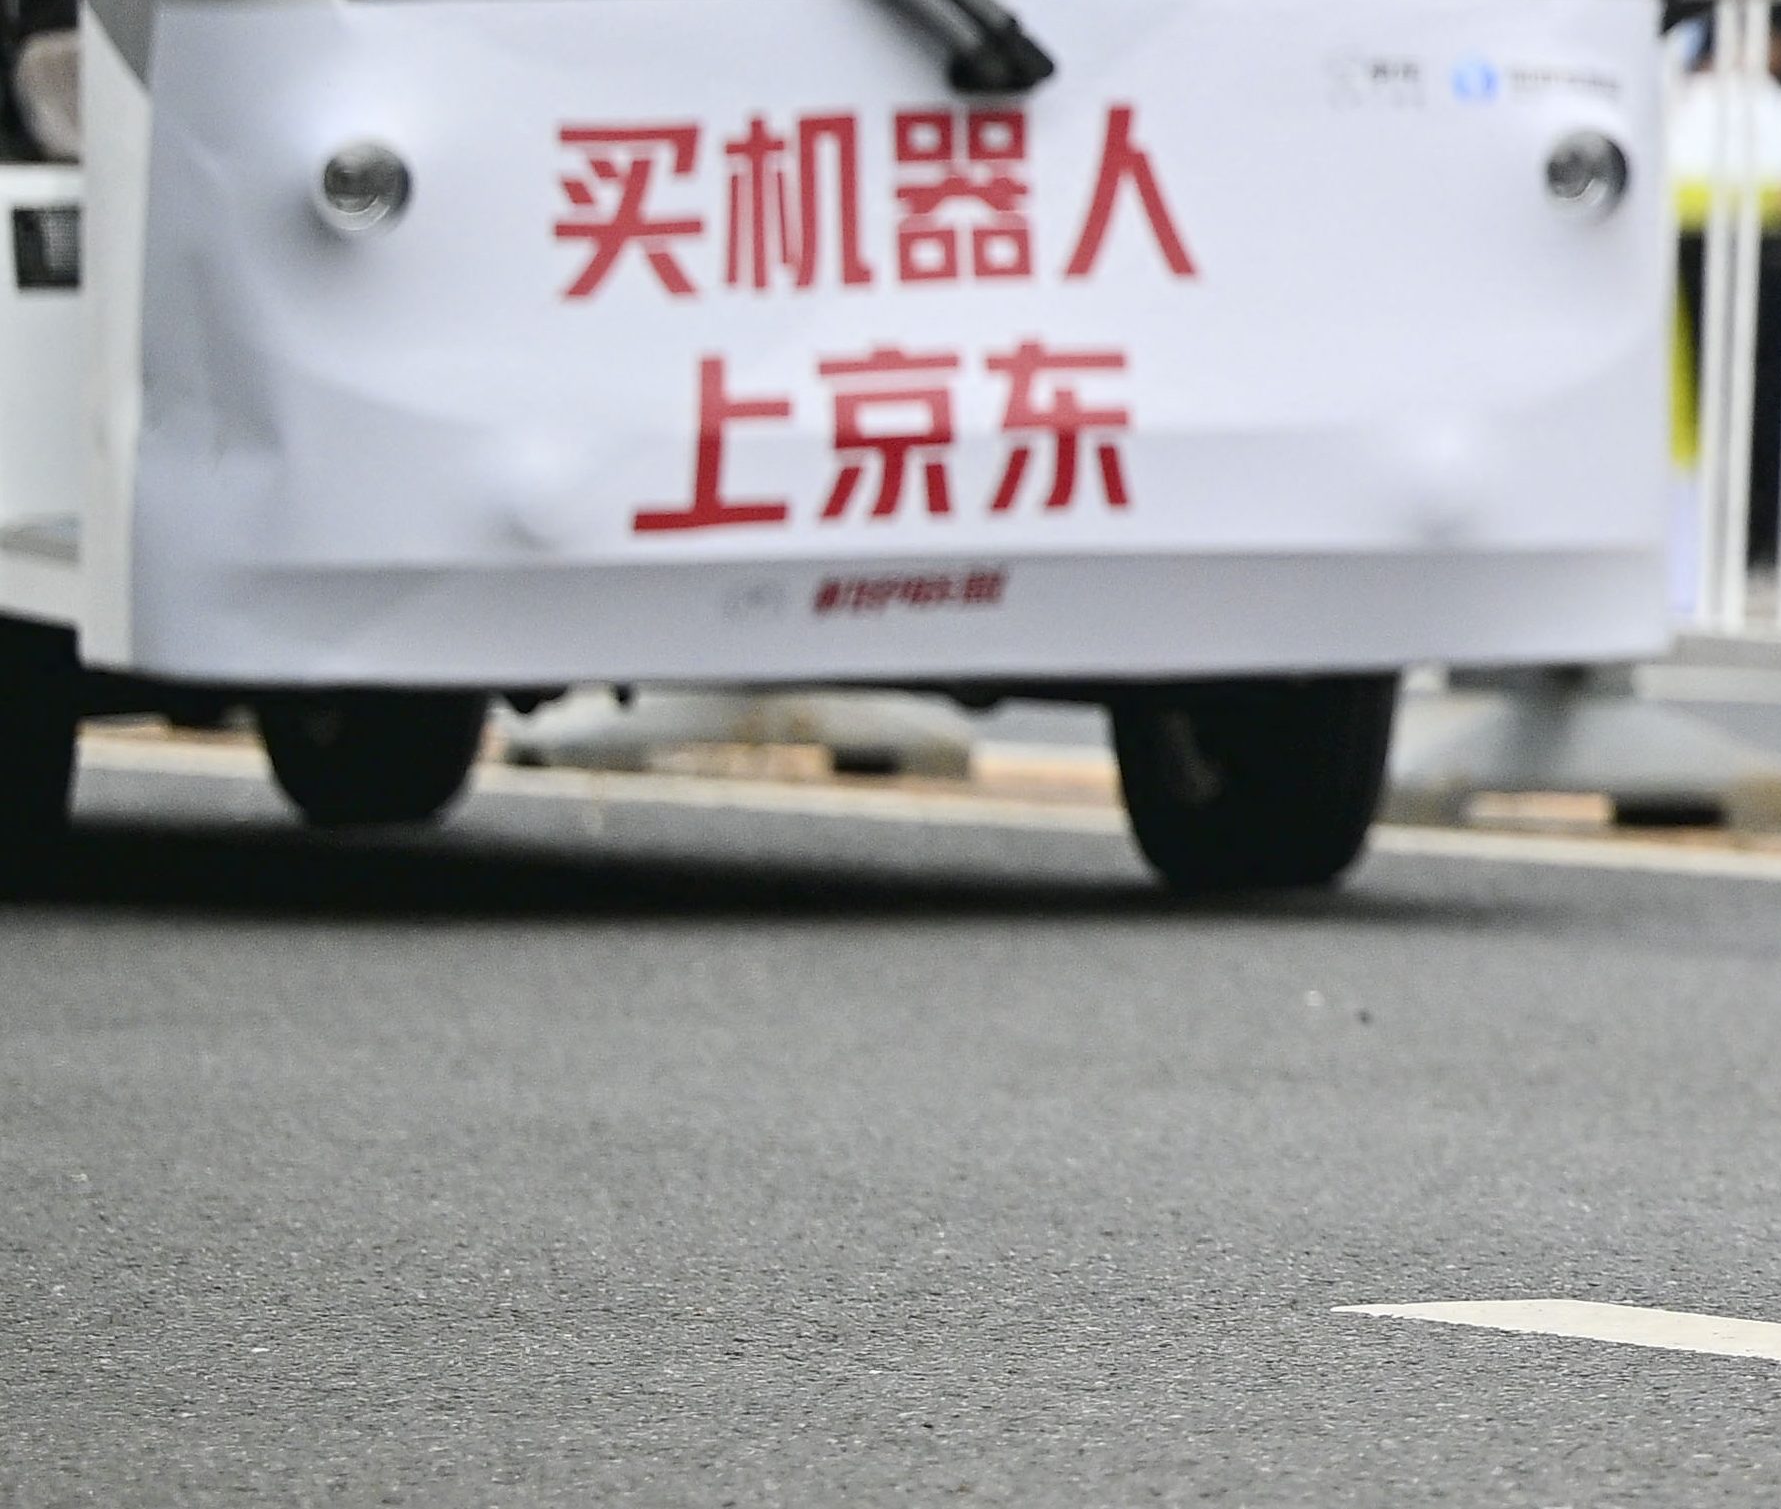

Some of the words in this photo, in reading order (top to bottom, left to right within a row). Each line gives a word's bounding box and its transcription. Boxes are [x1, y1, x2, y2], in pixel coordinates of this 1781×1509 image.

[553, 103, 1200, 300] 买机器人
[632, 337, 1131, 534] 上京东
